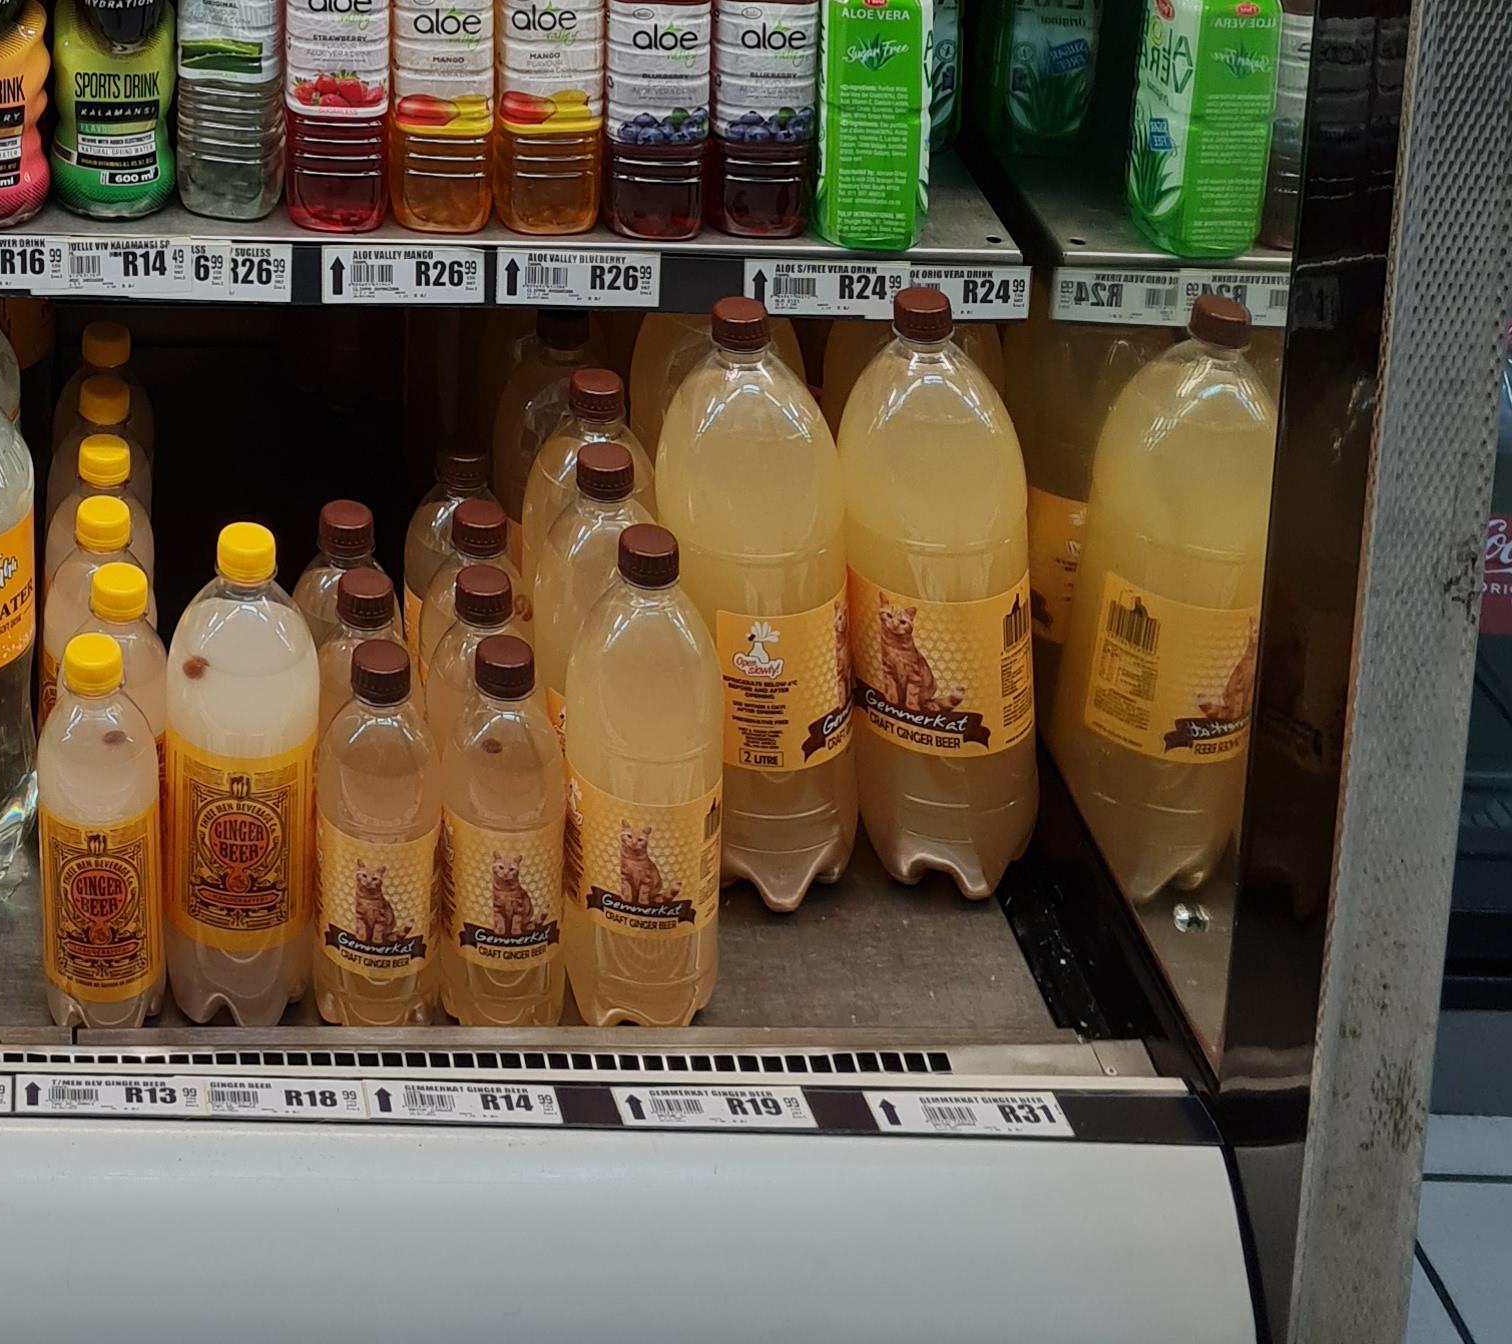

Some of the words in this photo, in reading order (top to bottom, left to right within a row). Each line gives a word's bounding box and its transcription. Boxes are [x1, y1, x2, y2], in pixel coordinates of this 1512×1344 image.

[842, 8, 874, 19] ALOE
[878, 9, 909, 20] VERA
[75, 71, 119, 99] SPORTS
[124, 70, 160, 97] DRINK
[415, 261, 462, 287] R26
[465, 261, 476, 275] 99
[839, 274, 887, 300] R24
[865, 689, 967, 733] Gemmerkat
[753, 753, 779, 766] LITRE
[214, 825, 264, 843] GINGER
[219, 842, 258, 862] BEER
[285, 1089, 336, 1108] R18
[342, 1090, 357, 1101] 99
[998, 1103, 1056, 1123] R31
